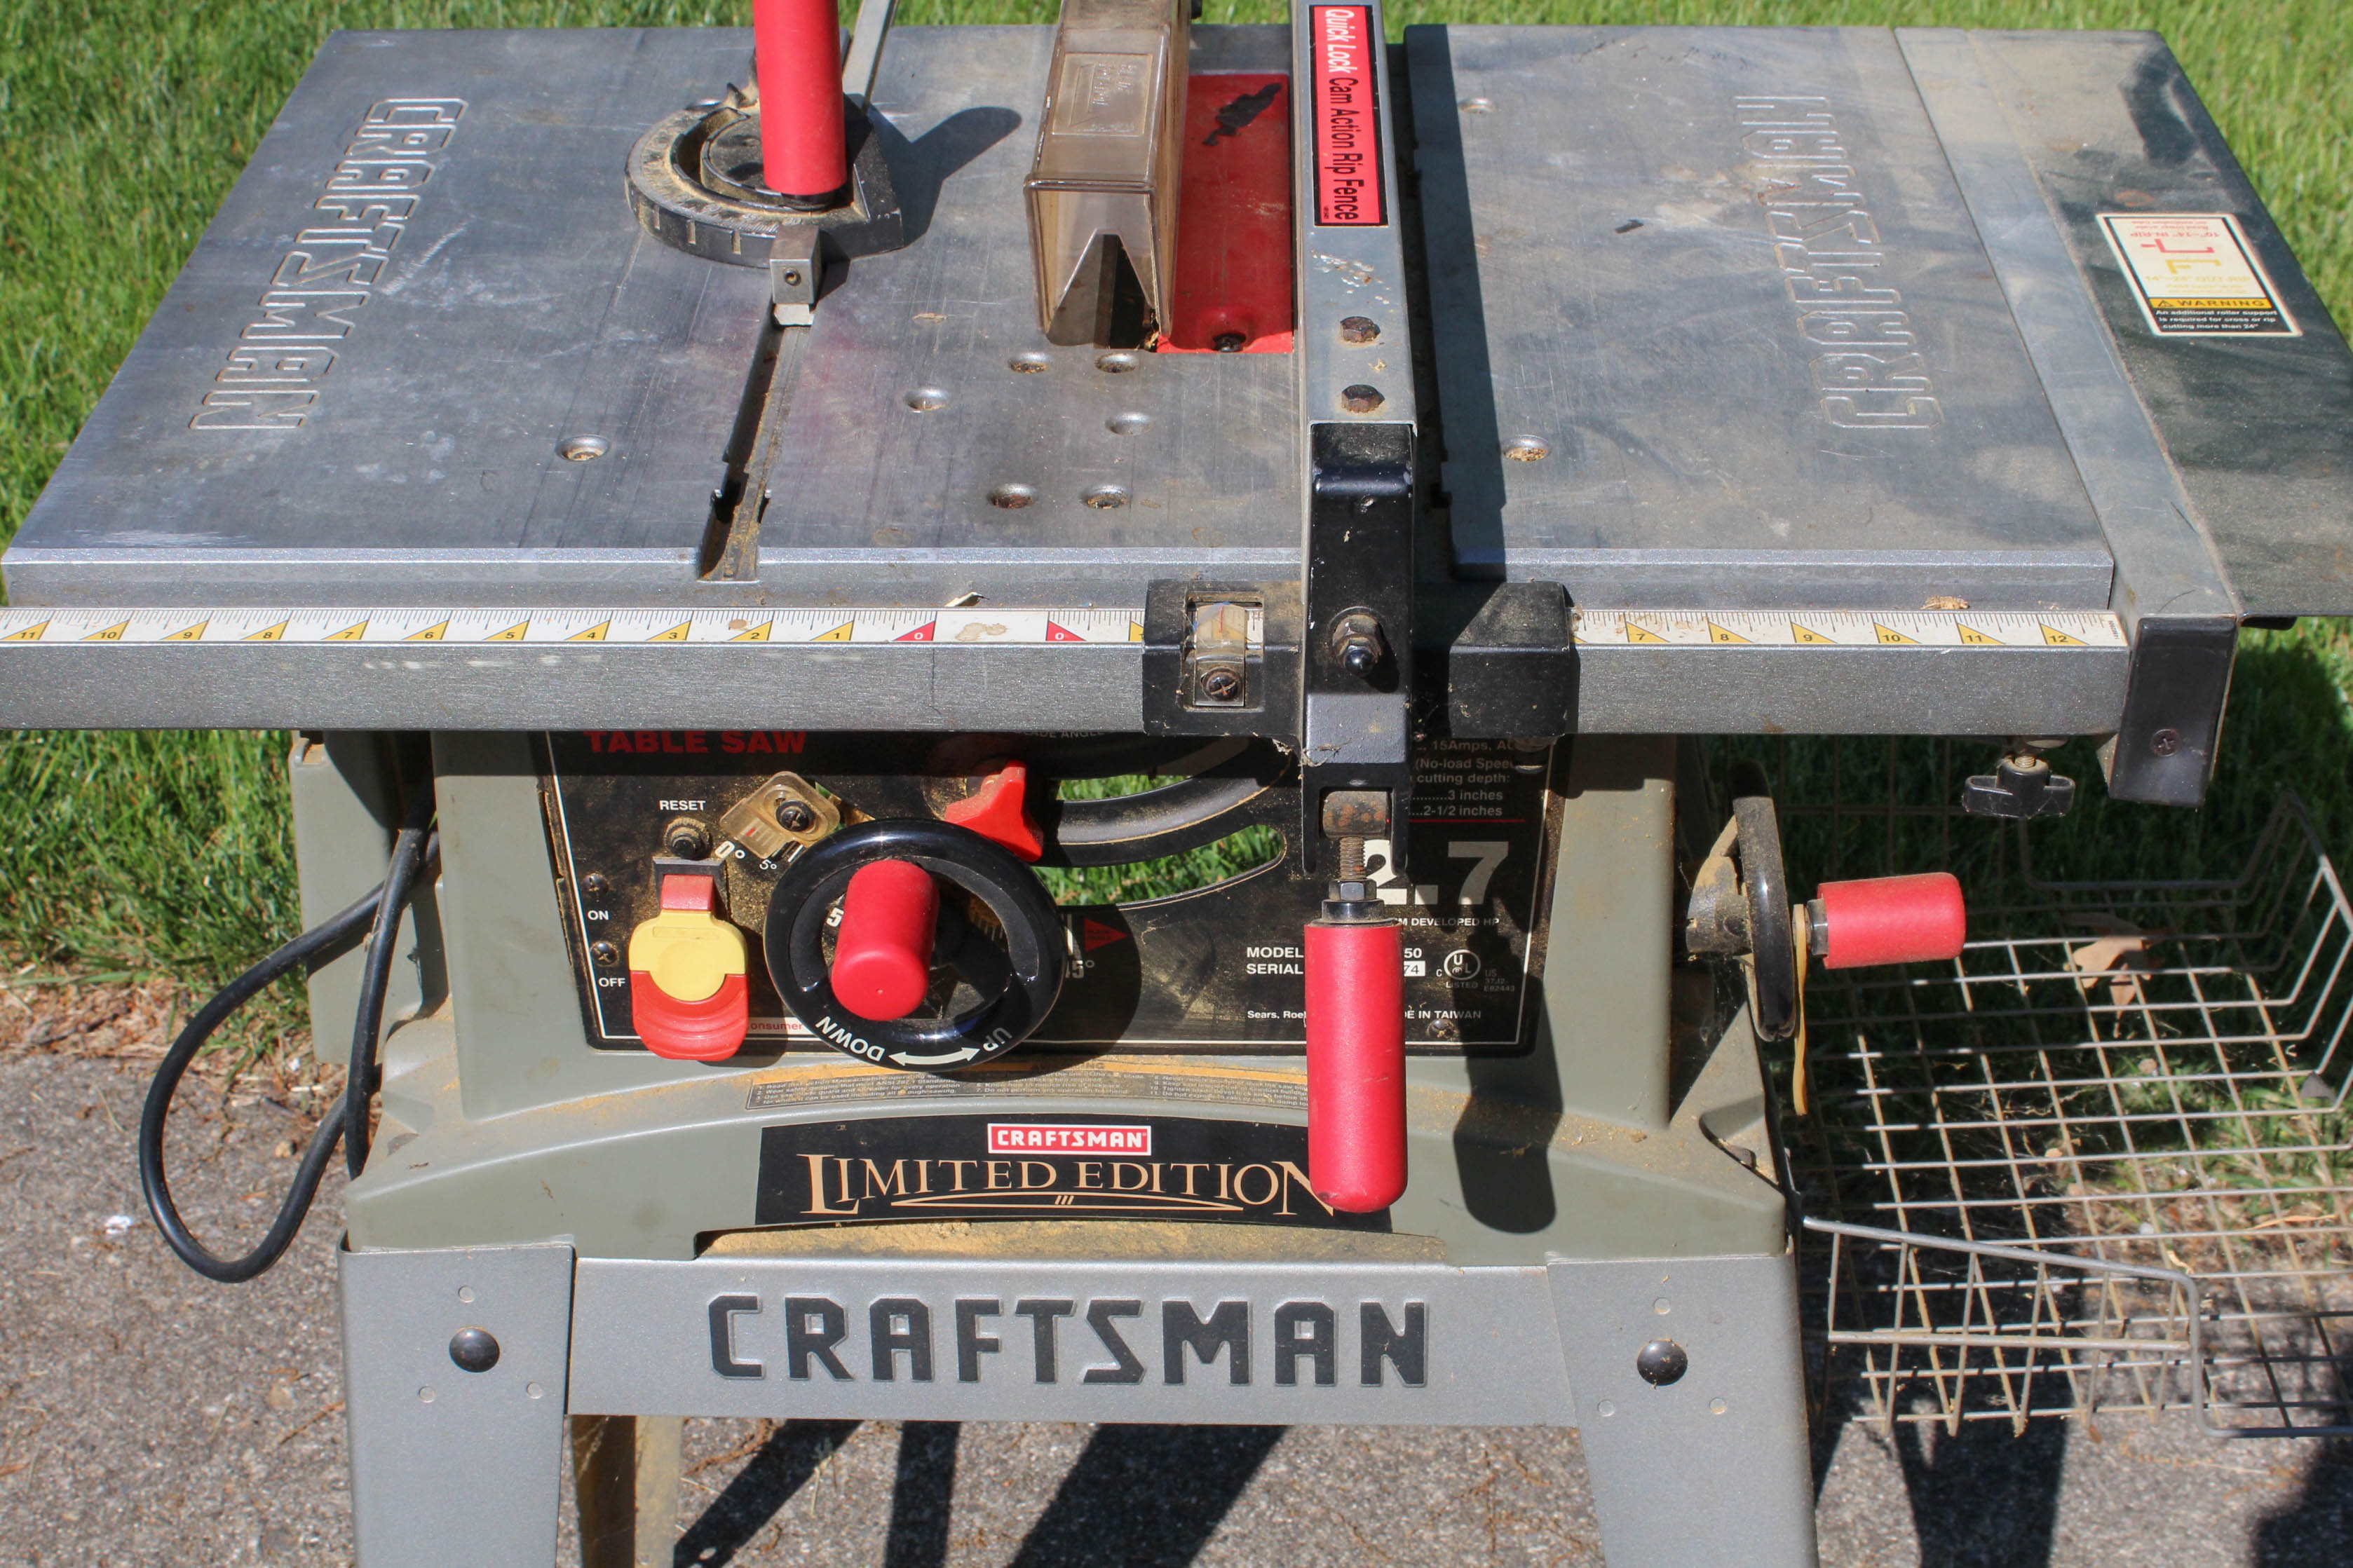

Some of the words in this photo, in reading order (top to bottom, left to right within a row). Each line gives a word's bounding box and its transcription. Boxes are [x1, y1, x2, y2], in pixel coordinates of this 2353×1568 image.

[1325, 9, 1356, 42] Quick
[1327, 46, 1358, 73] Lock
[1329, 77, 1359, 104] Cam
[1331, 108, 1362, 148] Action
[1324, 153, 1363, 174] Rip
[1334, 178, 1364, 220] Fence
[189, 97, 468, 430] CRAFTSMAN
[1734, 95, 1944, 429] CRAFTSMAN
[424, 632, 435, 640] 6
[506, 632, 515, 640] 5
[586, 632, 597, 640] 4
[668, 632, 678, 640] 3
[750, 632, 761, 640] 2
[834, 632, 841, 640] 1
[914, 632, 923, 641] 0
[1055, 632, 1064, 641] 0
[1721, 633, 1730, 641] 8
[1883, 634, 1901, 643] 10
[1966, 634, 1983, 643] 11
[2049, 634, 2069, 643] 12
[583, 730, 708, 754] TABLE
[721, 730, 806, 754] SAW
[1415, 758, 1472, 770] (No-load
[1416, 774, 1463, 785] cutting
[1467, 774, 1510, 784] depth:
[1459, 790, 1504, 800] inches
[659, 800, 706, 811] RESET
[1458, 805, 1503, 816] inches
[1364, 839, 1509, 905] 2.7
[587, 911, 609, 920] ON
[1411, 917, 1480, 927] DEVELOPED
[1483, 918, 1500, 927] HP
[1247, 946, 1304, 958] MODEL
[1246, 963, 1304, 975] SERIAL
[598, 977, 626, 988] OFF
[1418, 1010, 1431, 1019] IN
[1434, 1010, 1481, 1019] TAIWAN
[749, 1022, 803, 1031] onsumer
[815, 1016, 885, 1062] DOWN
[982, 1027, 1013, 1052] UP
[998, 1129, 1143, 1148] CRAFTSMAN
[796, 1154, 1057, 1215] LIMITED
[1073, 1161, 1334, 1217] EDITION
[708, 1293, 1428, 1388] CRAFTSMAN
